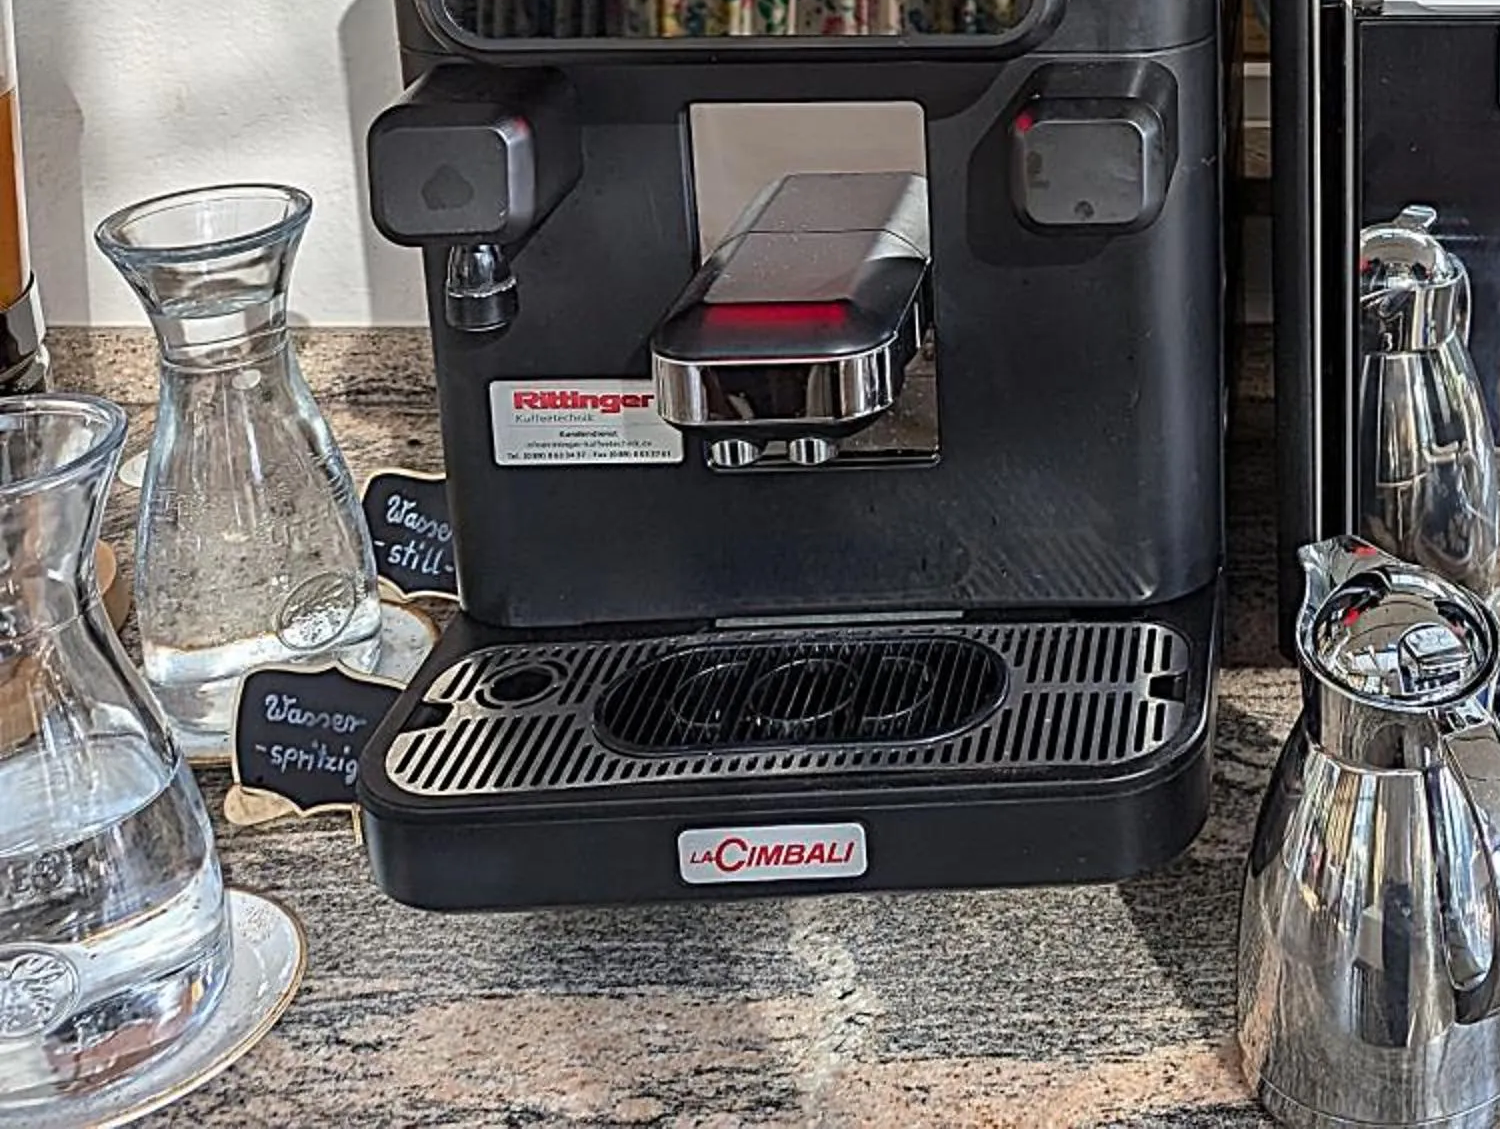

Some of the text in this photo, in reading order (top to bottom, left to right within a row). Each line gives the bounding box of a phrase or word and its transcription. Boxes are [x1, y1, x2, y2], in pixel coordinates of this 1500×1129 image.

[514, 390, 655, 413] Rittinger
[386, 494, 453, 542] Wasse
[264, 694, 368, 733] Wasser
